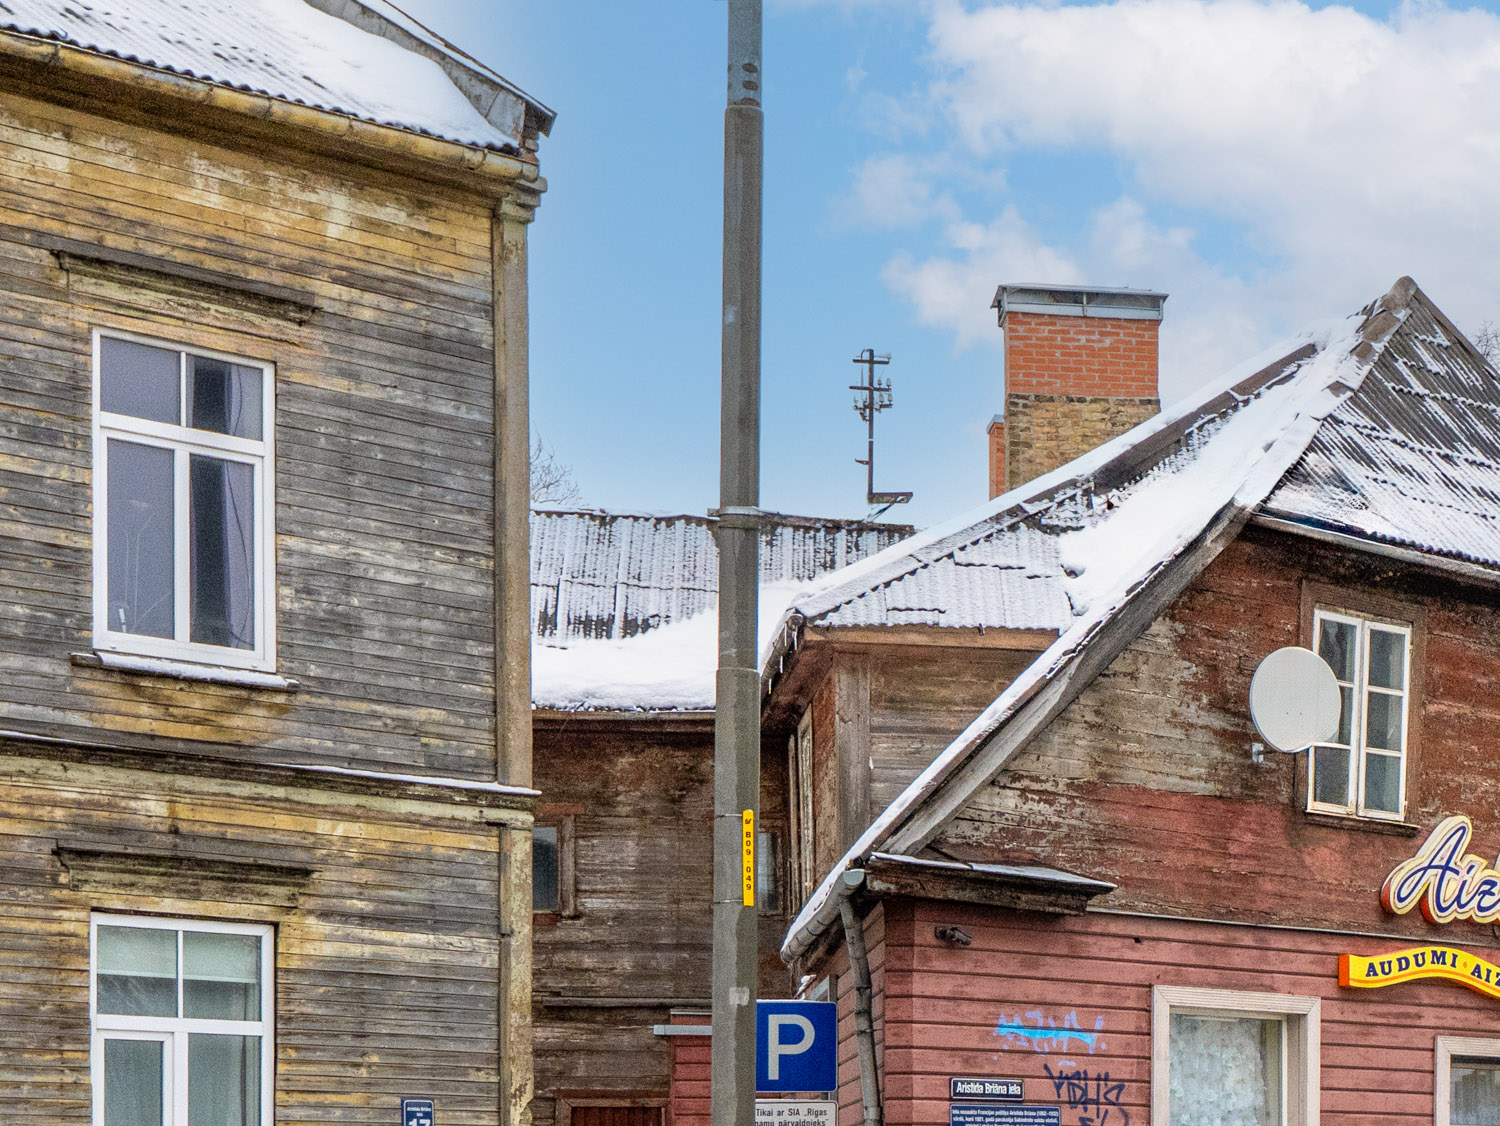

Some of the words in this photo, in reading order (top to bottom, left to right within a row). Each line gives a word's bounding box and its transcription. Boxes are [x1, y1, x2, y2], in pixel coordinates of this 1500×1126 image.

[1365, 947, 1458, 977] AUDUMI
[768, 1014, 815, 1080] P
[956, 1082, 984, 1094] Aristida
[1008, 1083, 1021, 1095] iela
[756, 1108, 774, 1117] Tikai
[788, 1108, 801, 1116] SIA
